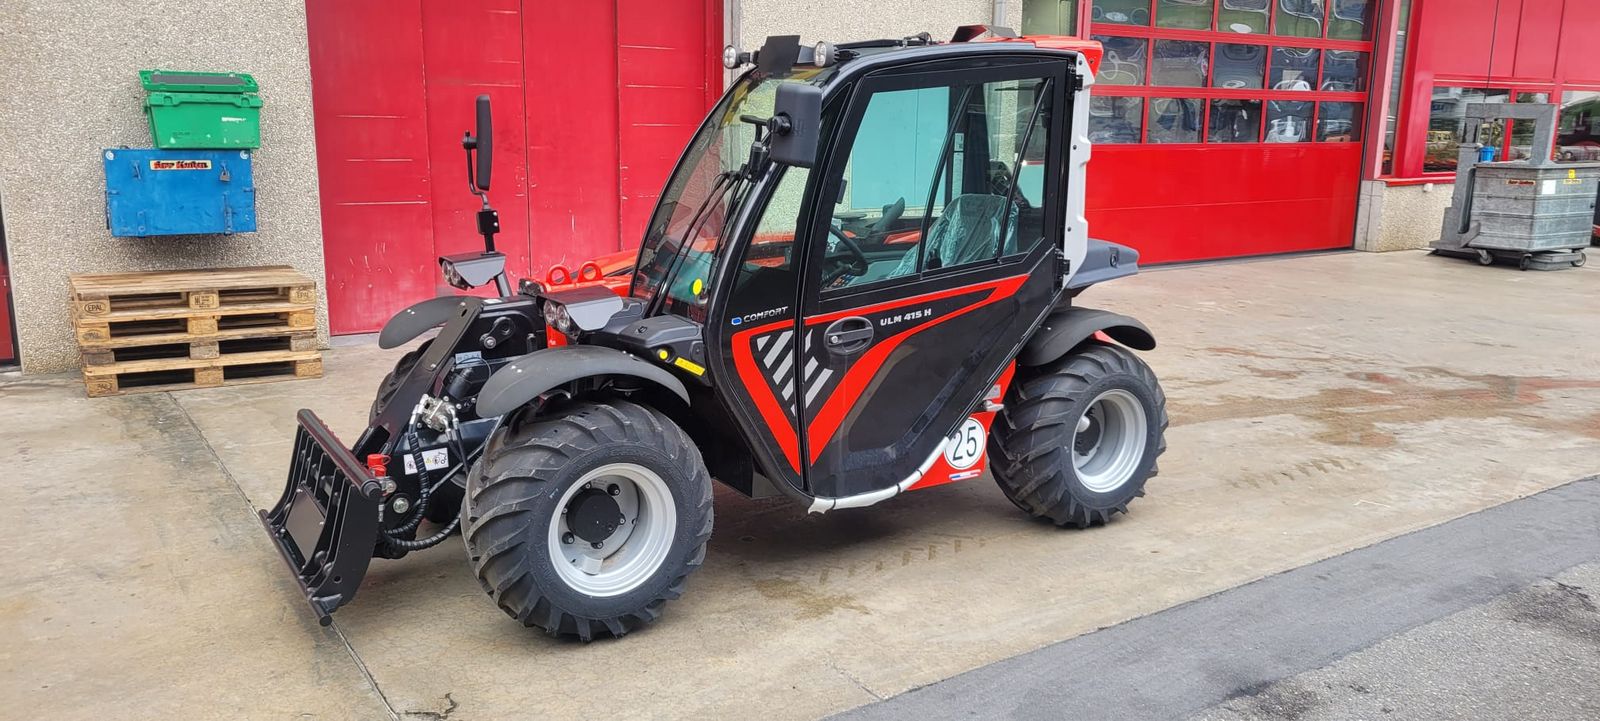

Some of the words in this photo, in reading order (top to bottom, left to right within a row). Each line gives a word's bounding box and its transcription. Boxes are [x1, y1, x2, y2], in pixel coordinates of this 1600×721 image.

[87, 304, 104, 312] EPAL
[743, 306, 789, 323] COMFORT
[880, 315, 902, 326] ULM
[904, 310, 922, 321] 415
[924, 308, 932, 317] H
[952, 426, 977, 461] 25
